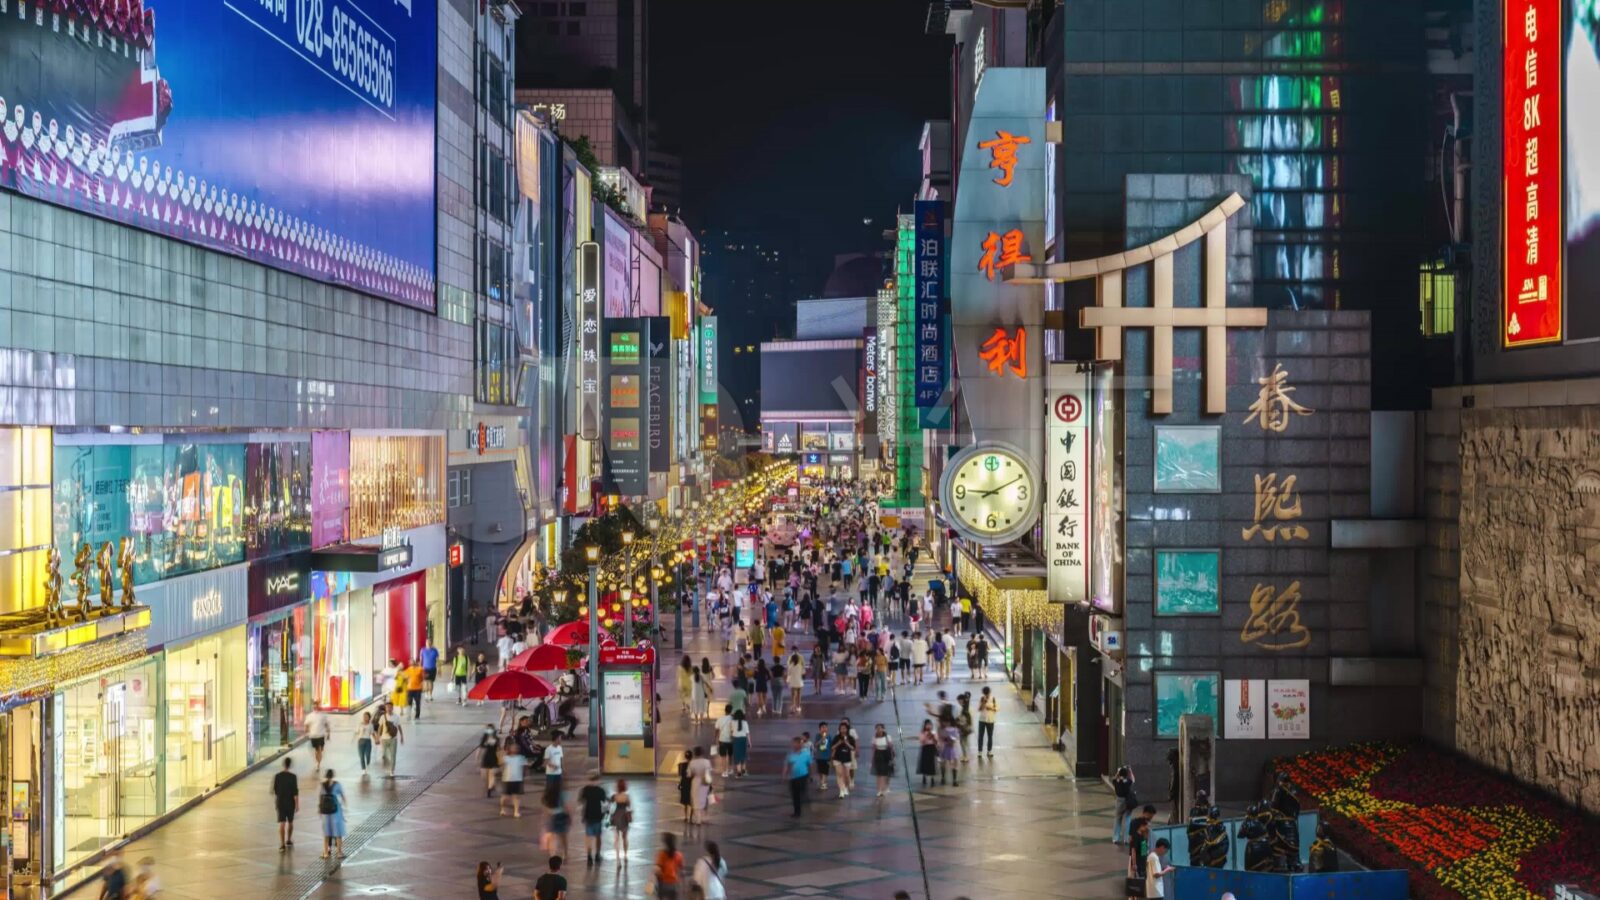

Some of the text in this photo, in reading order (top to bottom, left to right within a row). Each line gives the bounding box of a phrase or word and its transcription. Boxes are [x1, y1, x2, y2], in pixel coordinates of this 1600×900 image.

[295, 0, 393, 108] 028-85565566
[920, 238, 938, 383] 泊联汇时尚酒店
[583, 287, 598, 395] 爱恋珠宝
[649, 366, 661, 449] PEACEBIRD
[955, 485, 966, 500] 9
[1017, 485, 1028, 501] 3
[986, 513, 997, 528] 6
[1056, 543, 1080, 551] BANK
[1053, 559, 1082, 567] CHINA
